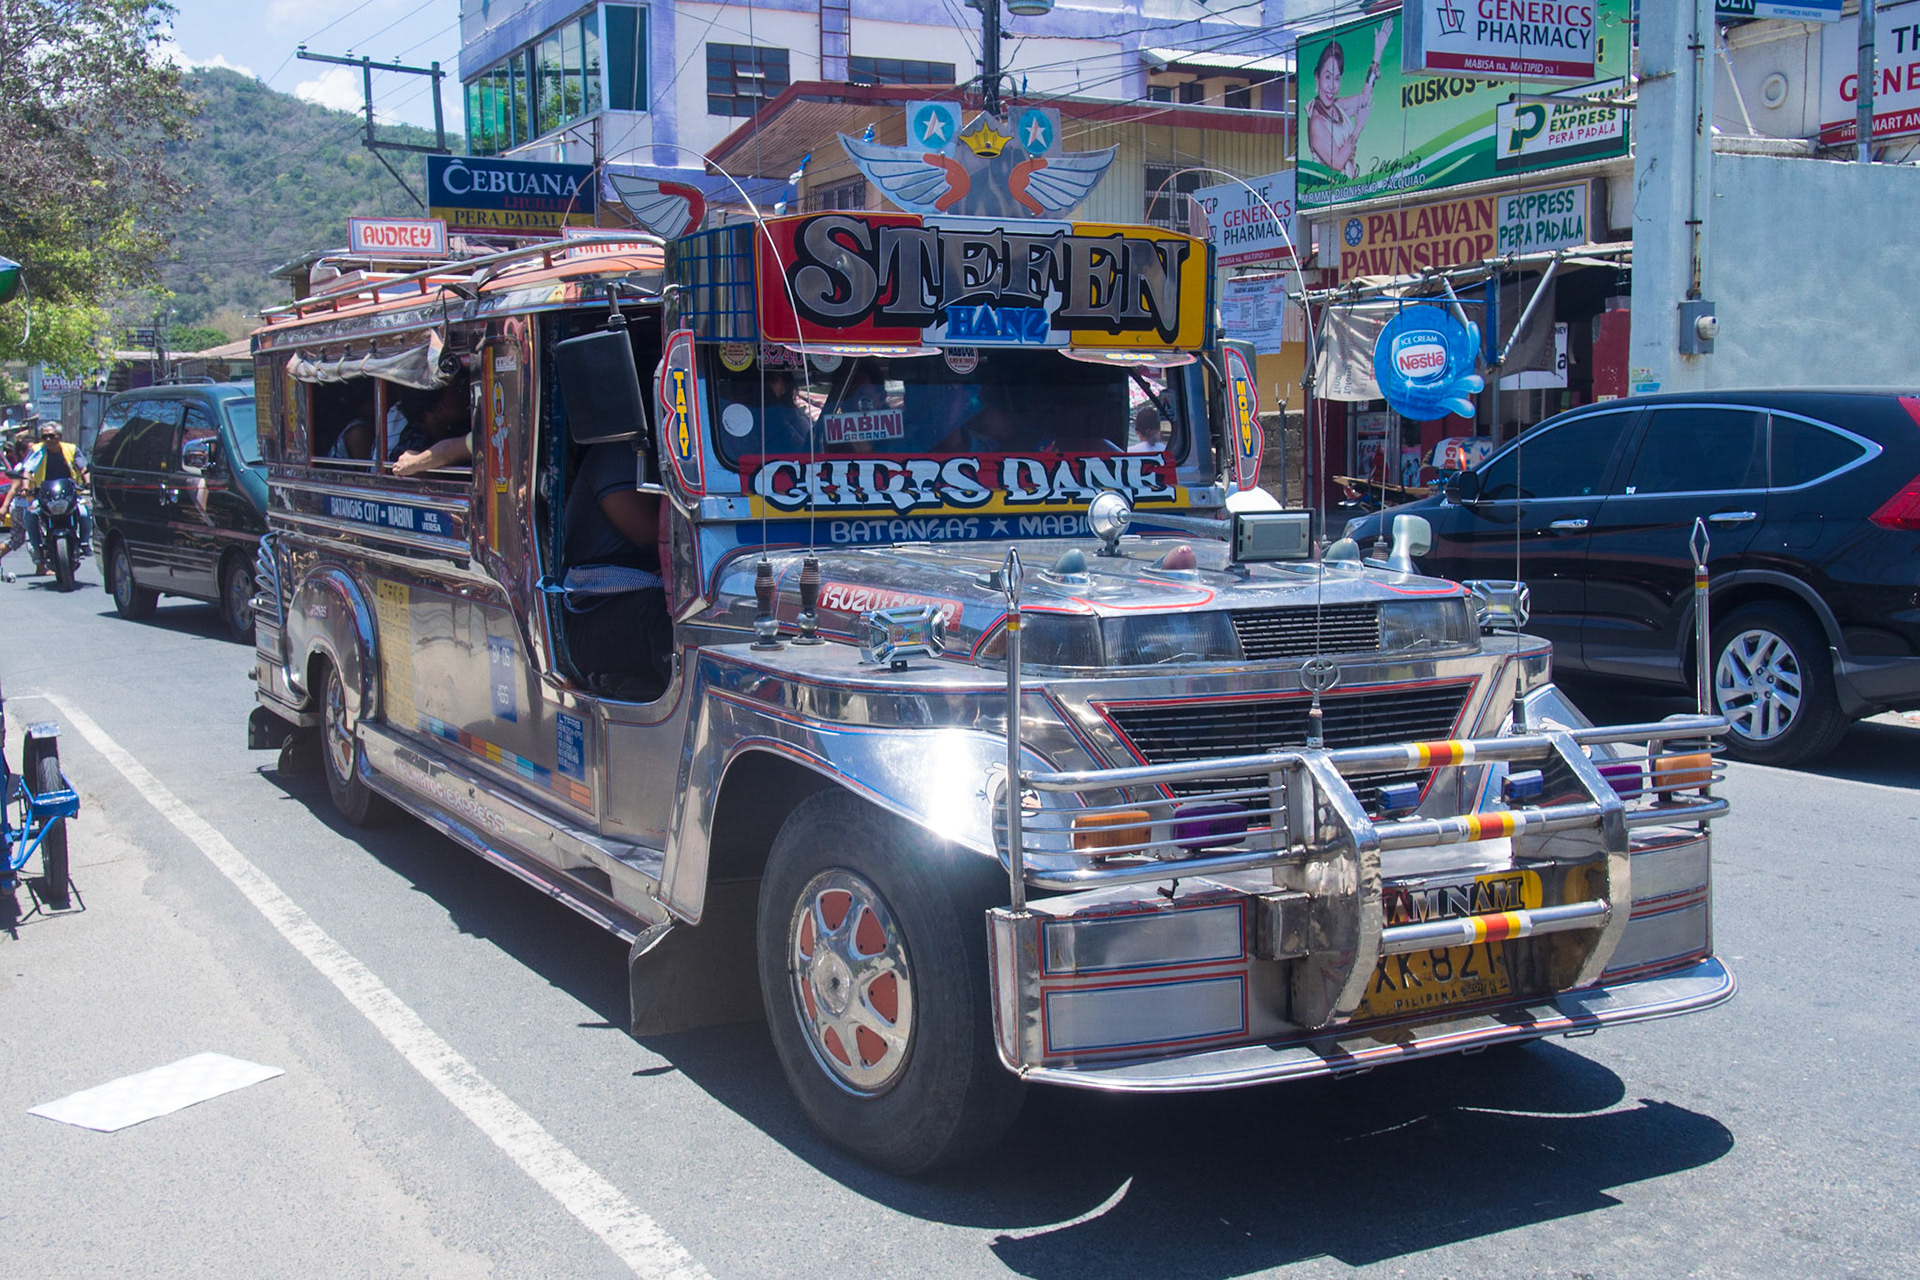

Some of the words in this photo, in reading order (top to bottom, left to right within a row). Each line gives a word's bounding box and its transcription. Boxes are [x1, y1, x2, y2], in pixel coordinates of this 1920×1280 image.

[1478, 0, 1592, 27] GENERICS
[1477, 20, 1592, 50] PHARMACY
[1464, 58, 1494, 69] MABISA
[1510, 61, 1543, 73] MATIPID
[1548, 130, 1574, 146] PERA
[1577, 122, 1616, 141] PADALA
[1549, 107, 1617, 133] EXPRESS
[443, 159, 581, 197] CEBUANA
[1301, 191, 1332, 205] MOMMY
[1334, 182, 1369, 200] DIONISIA
[1383, 173, 1426, 191] PACQUIAO
[1245, 185, 1269, 206] THE
[1507, 189, 1575, 221] EXPRESS
[454, 210, 500, 227] PERA
[505, 211, 572, 229] PADALA
[1223, 199, 1292, 228] GENERICS
[1367, 197, 1496, 246] PALAWAN
[362, 225, 432, 247] AUDREY
[1223, 218, 1292, 247] PHARMACY
[1499, 224, 1532, 250] PERA
[1536, 215, 1583, 245] PADALA
[1341, 234, 1494, 283] PAWNSHOP
[792, 214, 1188, 336] STEFEN
[945, 303, 1052, 344] HANZ
[1401, 337, 1412, 346] ICE
[1412, 335, 1438, 344] CREAM
[672, 371, 690, 458] TATAY
[826, 413, 902, 441] MABINI
[1236, 380, 1254, 456] MOMMY
[755, 457, 992, 509] CHRIS
[1003, 453, 1176, 503] DANE
[331, 497, 363, 519] BATANGAS
[364, 502, 380, 523] CITY
[387, 506, 414, 529] MABINI
[421, 521, 442, 533] VERSA
[423, 512, 438, 523] VICE
[830, 517, 979, 543] BATANGAS
